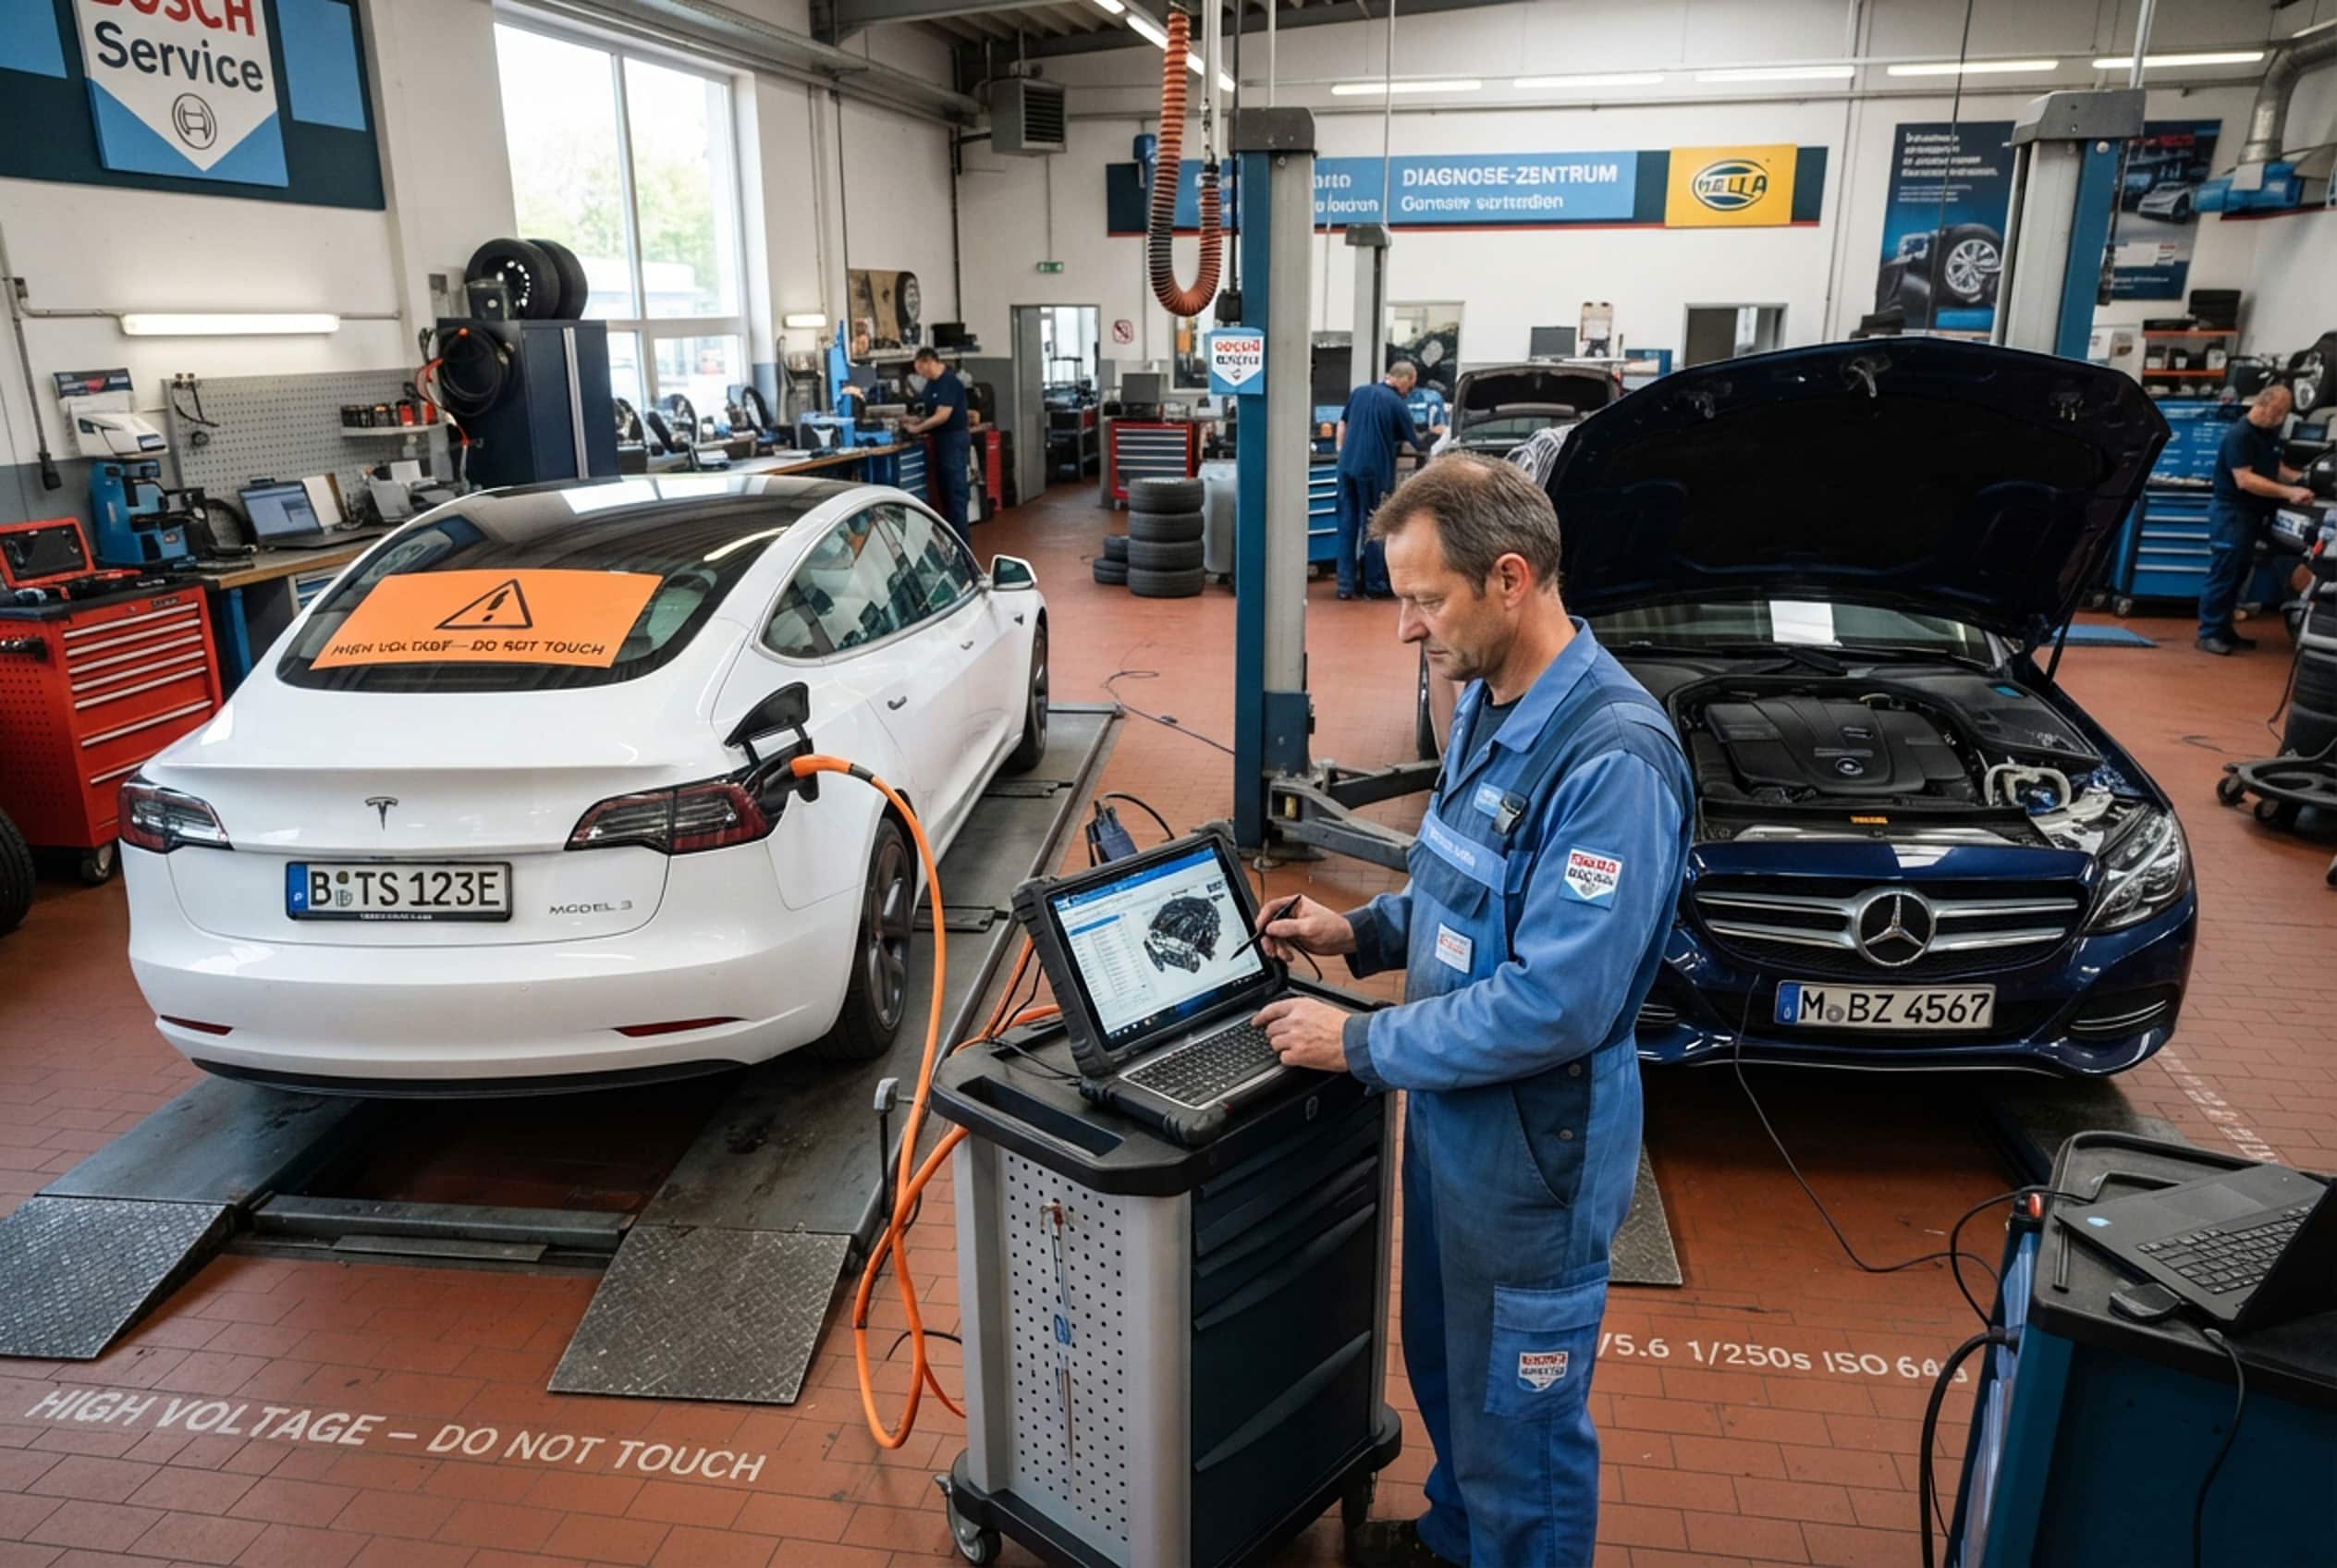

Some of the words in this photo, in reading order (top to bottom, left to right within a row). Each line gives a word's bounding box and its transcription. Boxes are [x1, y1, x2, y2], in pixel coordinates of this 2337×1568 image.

[94, 20, 263, 92] Service
[1401, 164, 1618, 187] DIAGNOSE-ZENTRUM
[544, 641, 606, 655] TOUCH
[310, 871, 332, 906] B
[355, 872, 399, 906] TS
[409, 871, 501, 906] 123E
[1800, 990, 1825, 1021] M
[1847, 993, 1895, 1023] BZ
[1903, 993, 1990, 1024] 4567
[1686, 1340, 1812, 1371] 1/250s
[1822, 1350, 1889, 1376] ISO
[24, 1389, 158, 1427] HIGH
[155, 1397, 387, 1446] VOLTAGE
[425, 1424, 498, 1455] DO
[503, 1429, 606, 1465] NOT
[612, 1439, 767, 1482] TOUCH
